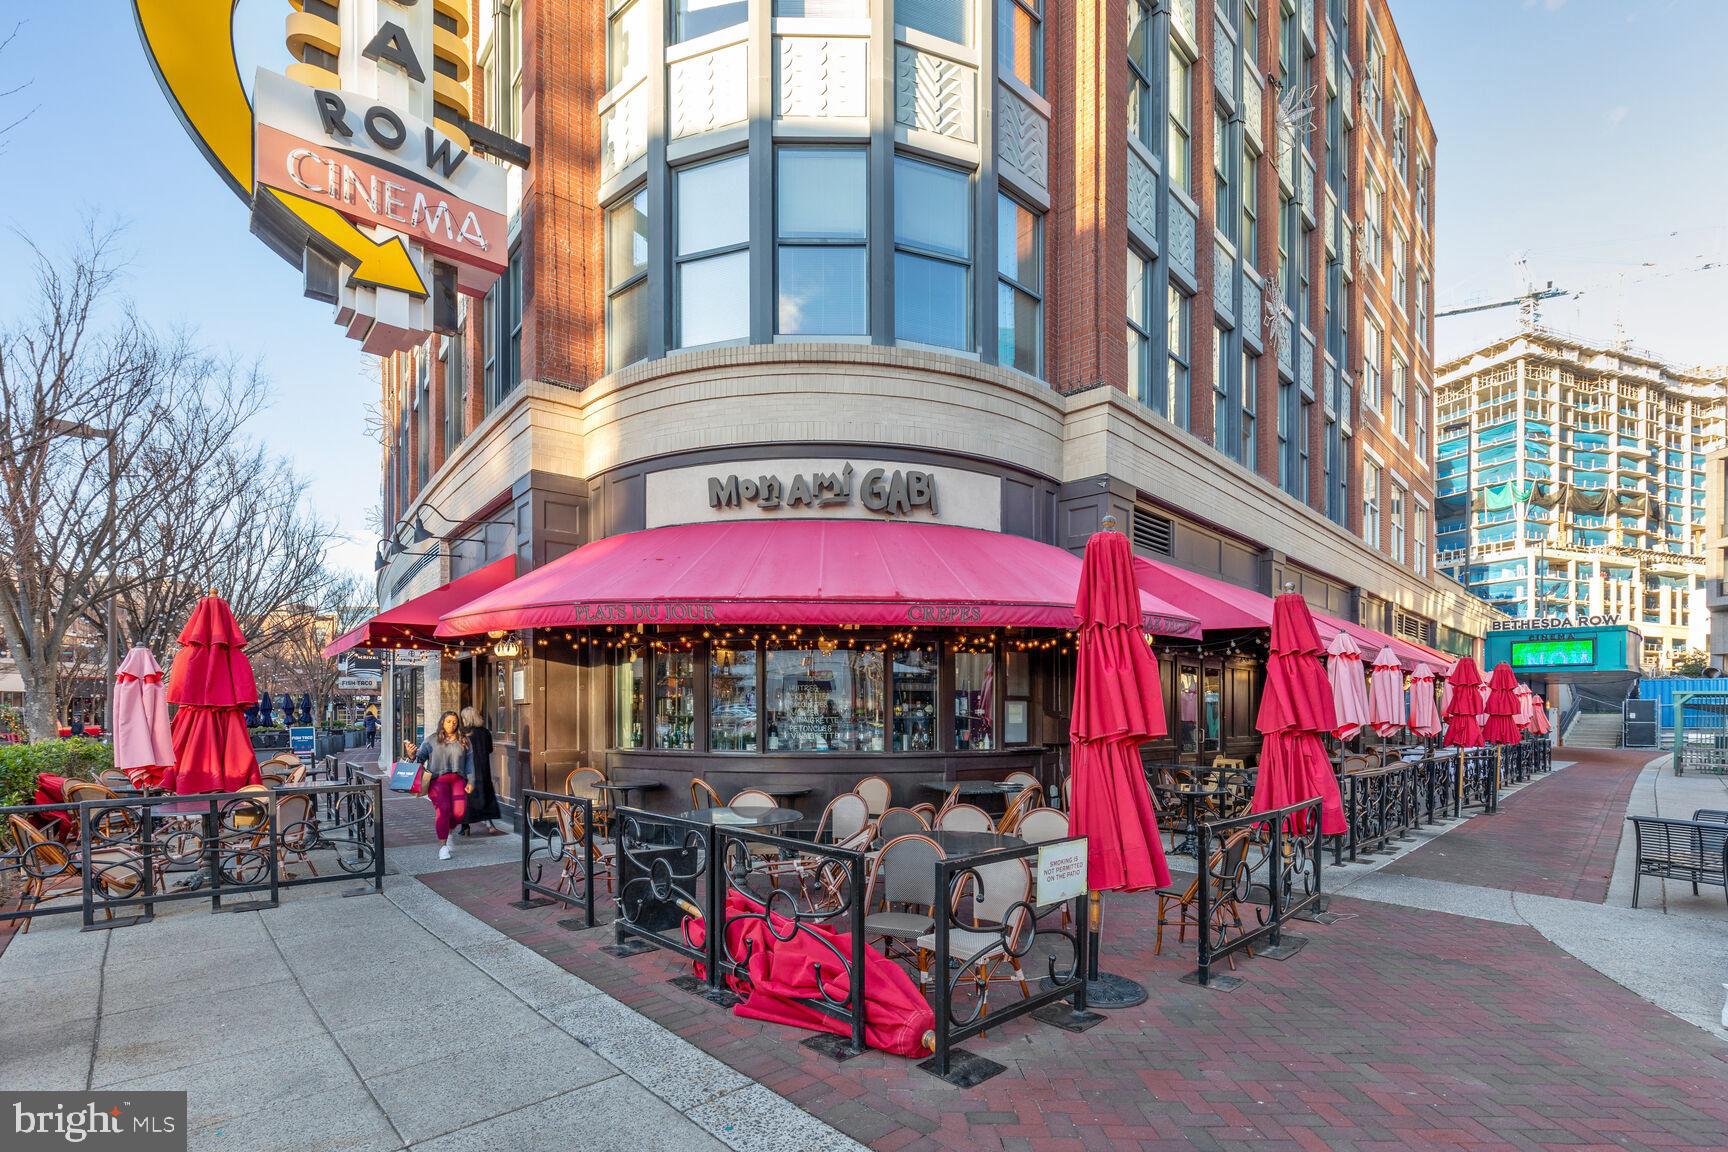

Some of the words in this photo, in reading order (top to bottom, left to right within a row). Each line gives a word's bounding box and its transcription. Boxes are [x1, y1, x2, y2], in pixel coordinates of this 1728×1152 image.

[313, 89, 468, 179] ROW
[286, 147, 488, 252] CINEMA
[860, 467, 939, 516] GABI
[574, 604, 627, 621] PLATS
[631, 604, 660, 620] DU
[664, 604, 716, 621] JOUR
[907, 605, 981, 622] CREPES
[1492, 617, 1573, 631] BETHESDA
[1578, 614, 1620, 627] ROW
[1528, 632, 1576, 641] CINEMA
[1043, 868, 1055, 876] NOT
[1056, 862, 1083, 872] PERMITTED
[1050, 857, 1073, 867] SMOKING
[1056, 872, 1066, 880] THE
